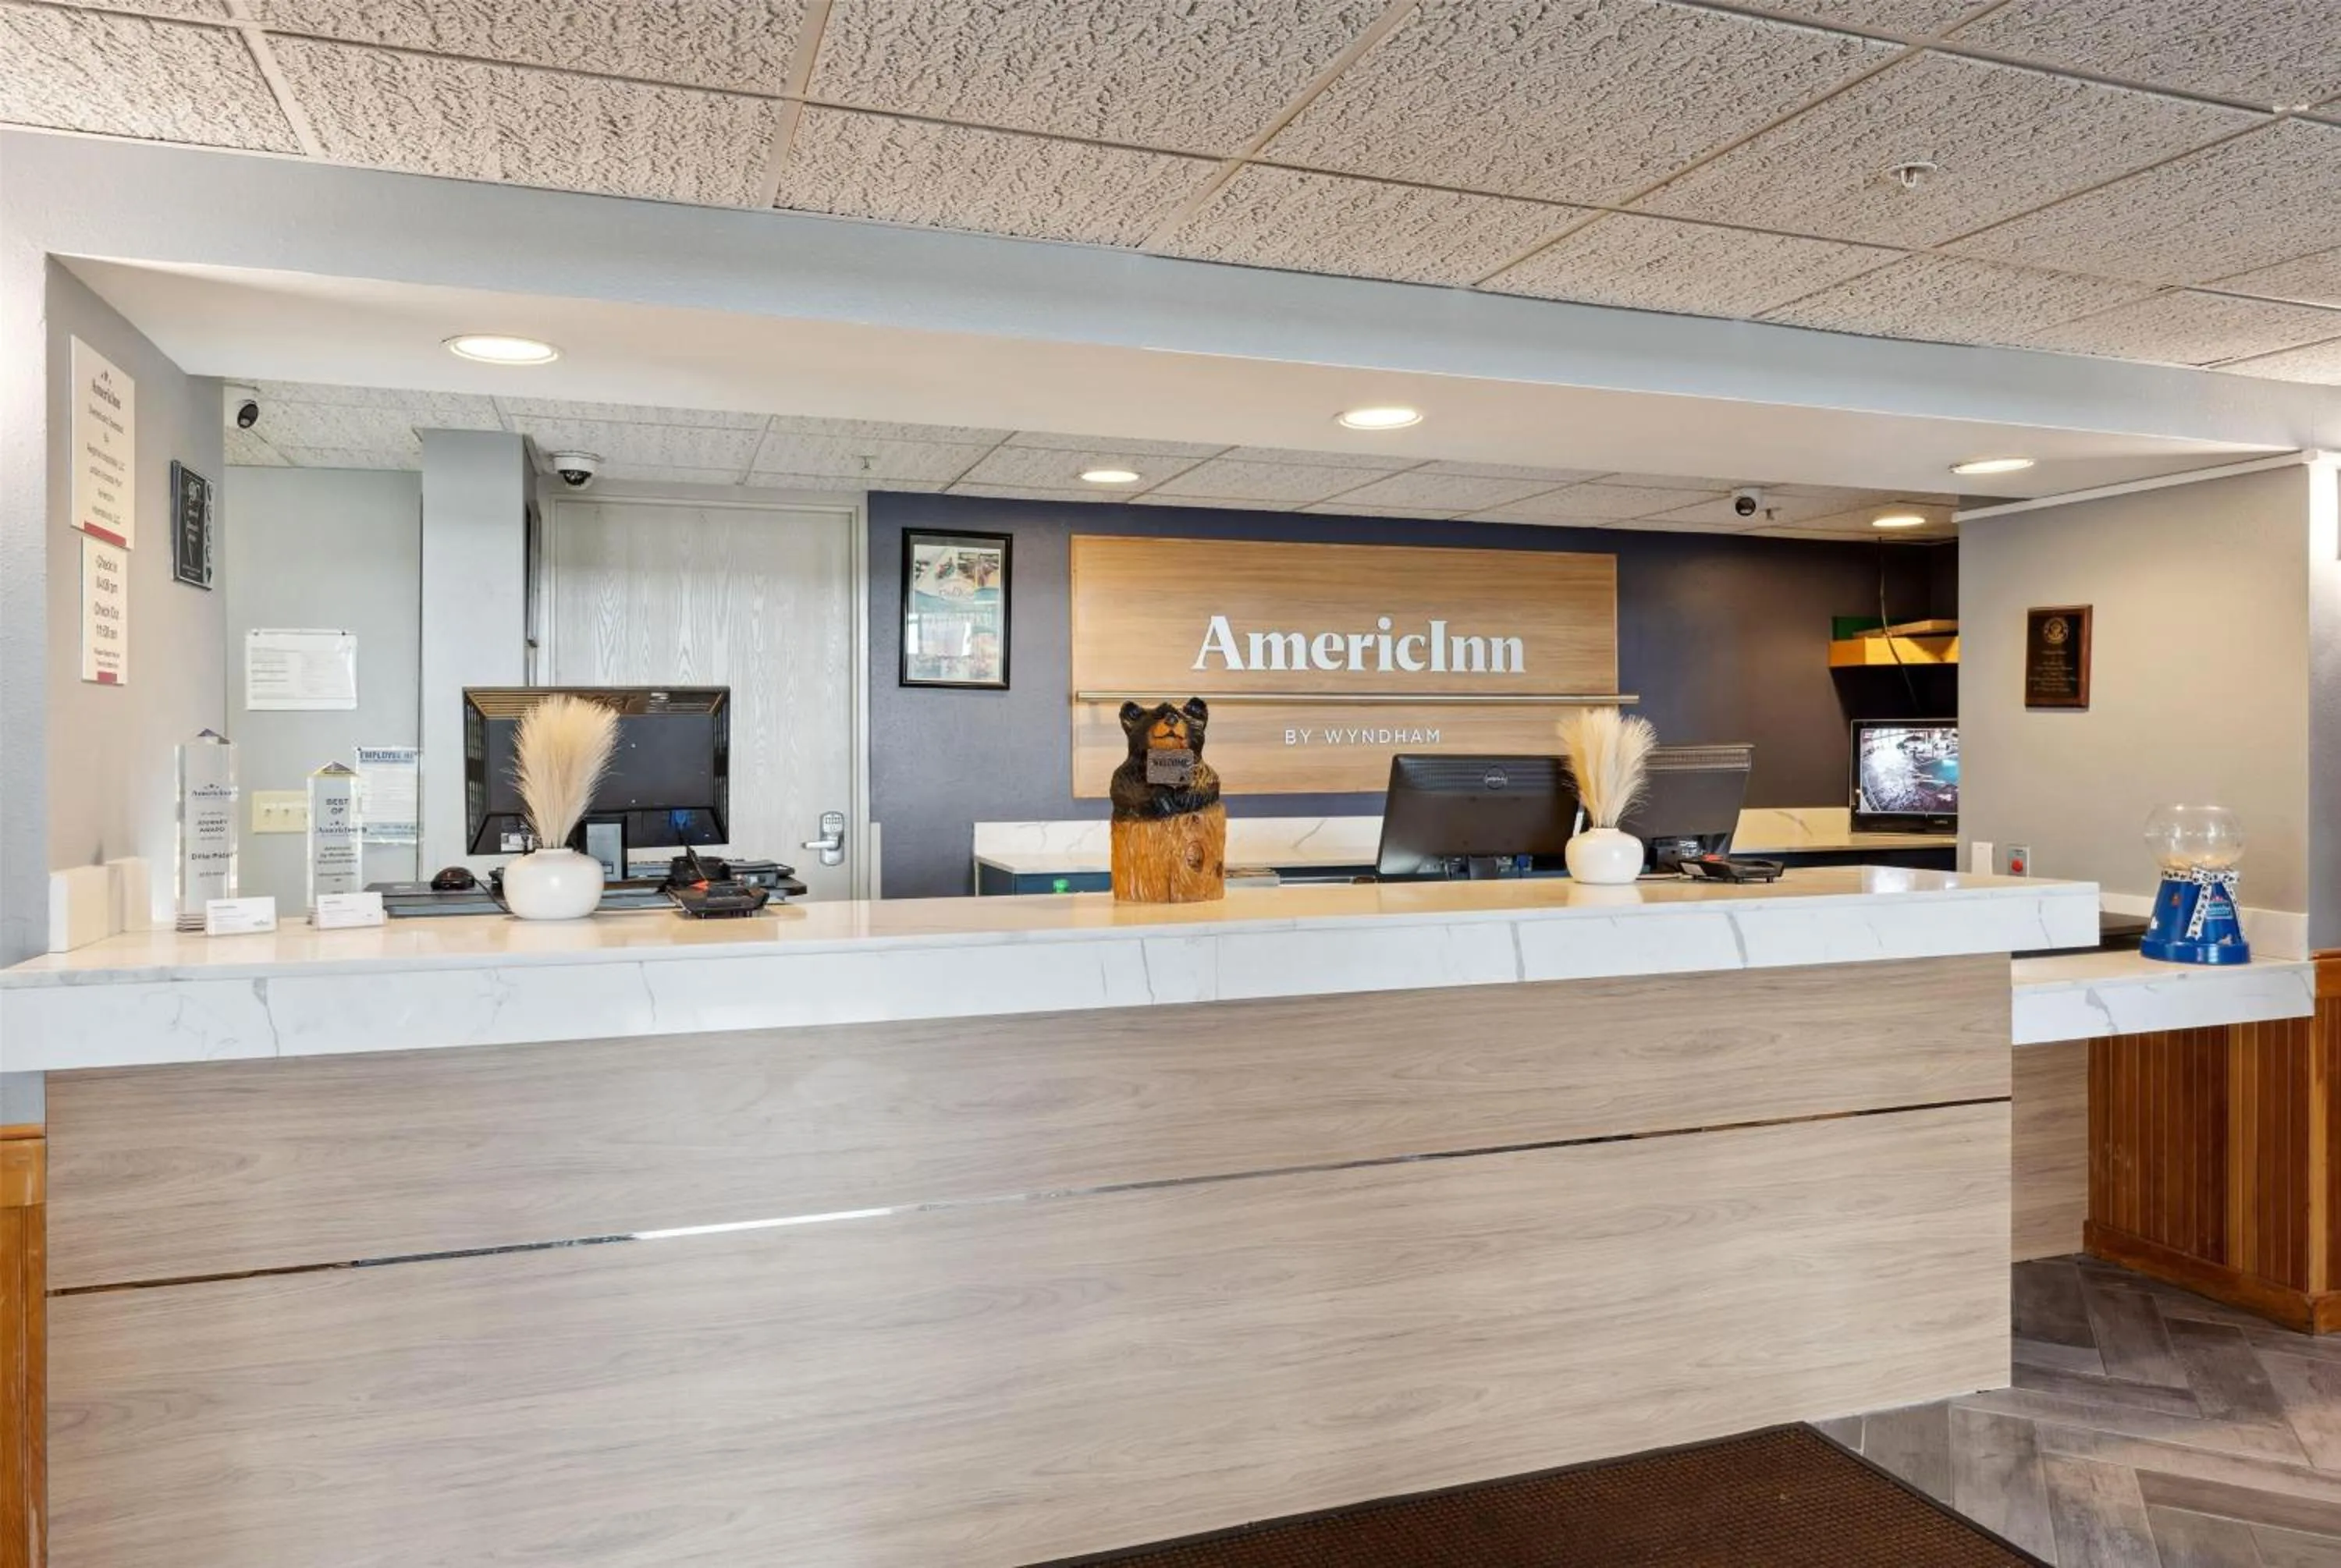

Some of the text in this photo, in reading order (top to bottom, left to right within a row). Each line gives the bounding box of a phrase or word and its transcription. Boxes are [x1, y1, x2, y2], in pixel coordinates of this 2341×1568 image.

[1190, 615, 1526, 673] AmericInn
[1284, 729, 1441, 745] BY WYNDHAM
[1153, 757, 1190, 768] WELCOME
